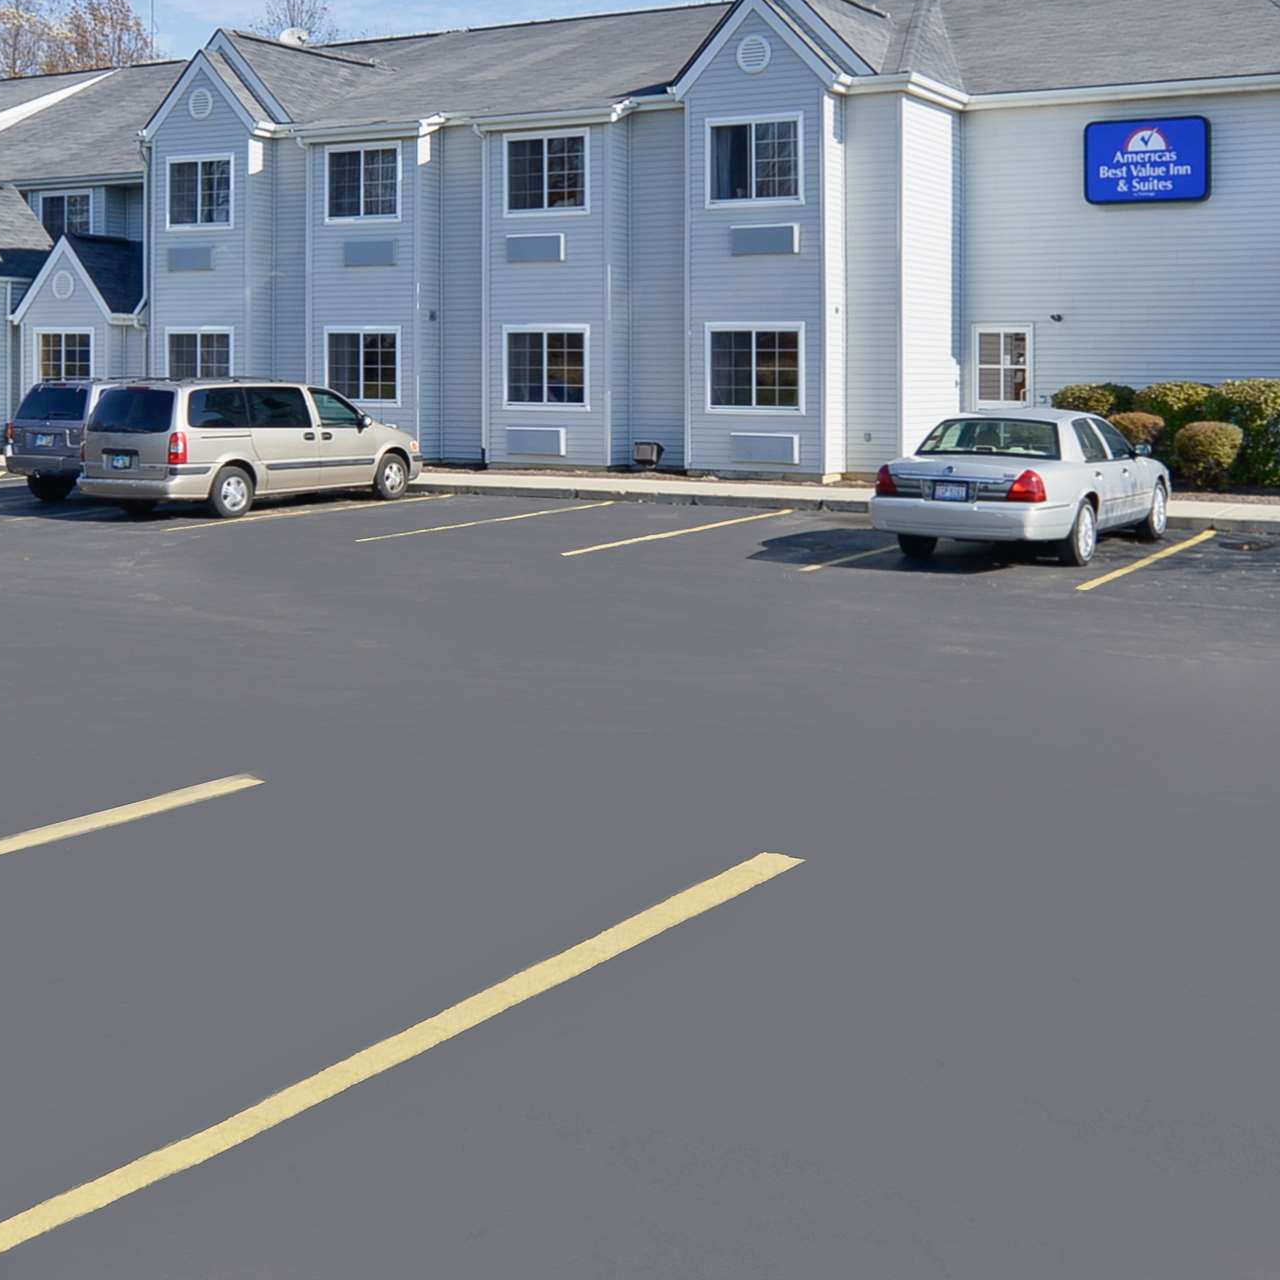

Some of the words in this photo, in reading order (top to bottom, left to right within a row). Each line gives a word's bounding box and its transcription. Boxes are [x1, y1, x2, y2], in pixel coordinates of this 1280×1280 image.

[1113, 151, 1177, 163] Americas
[1099, 166, 1127, 178] Best
[1130, 164, 1167, 177] Value
[1170, 163, 1191, 175] Inn
[1117, 180, 1128, 192] &
[1132, 178, 1173, 191] Suites
